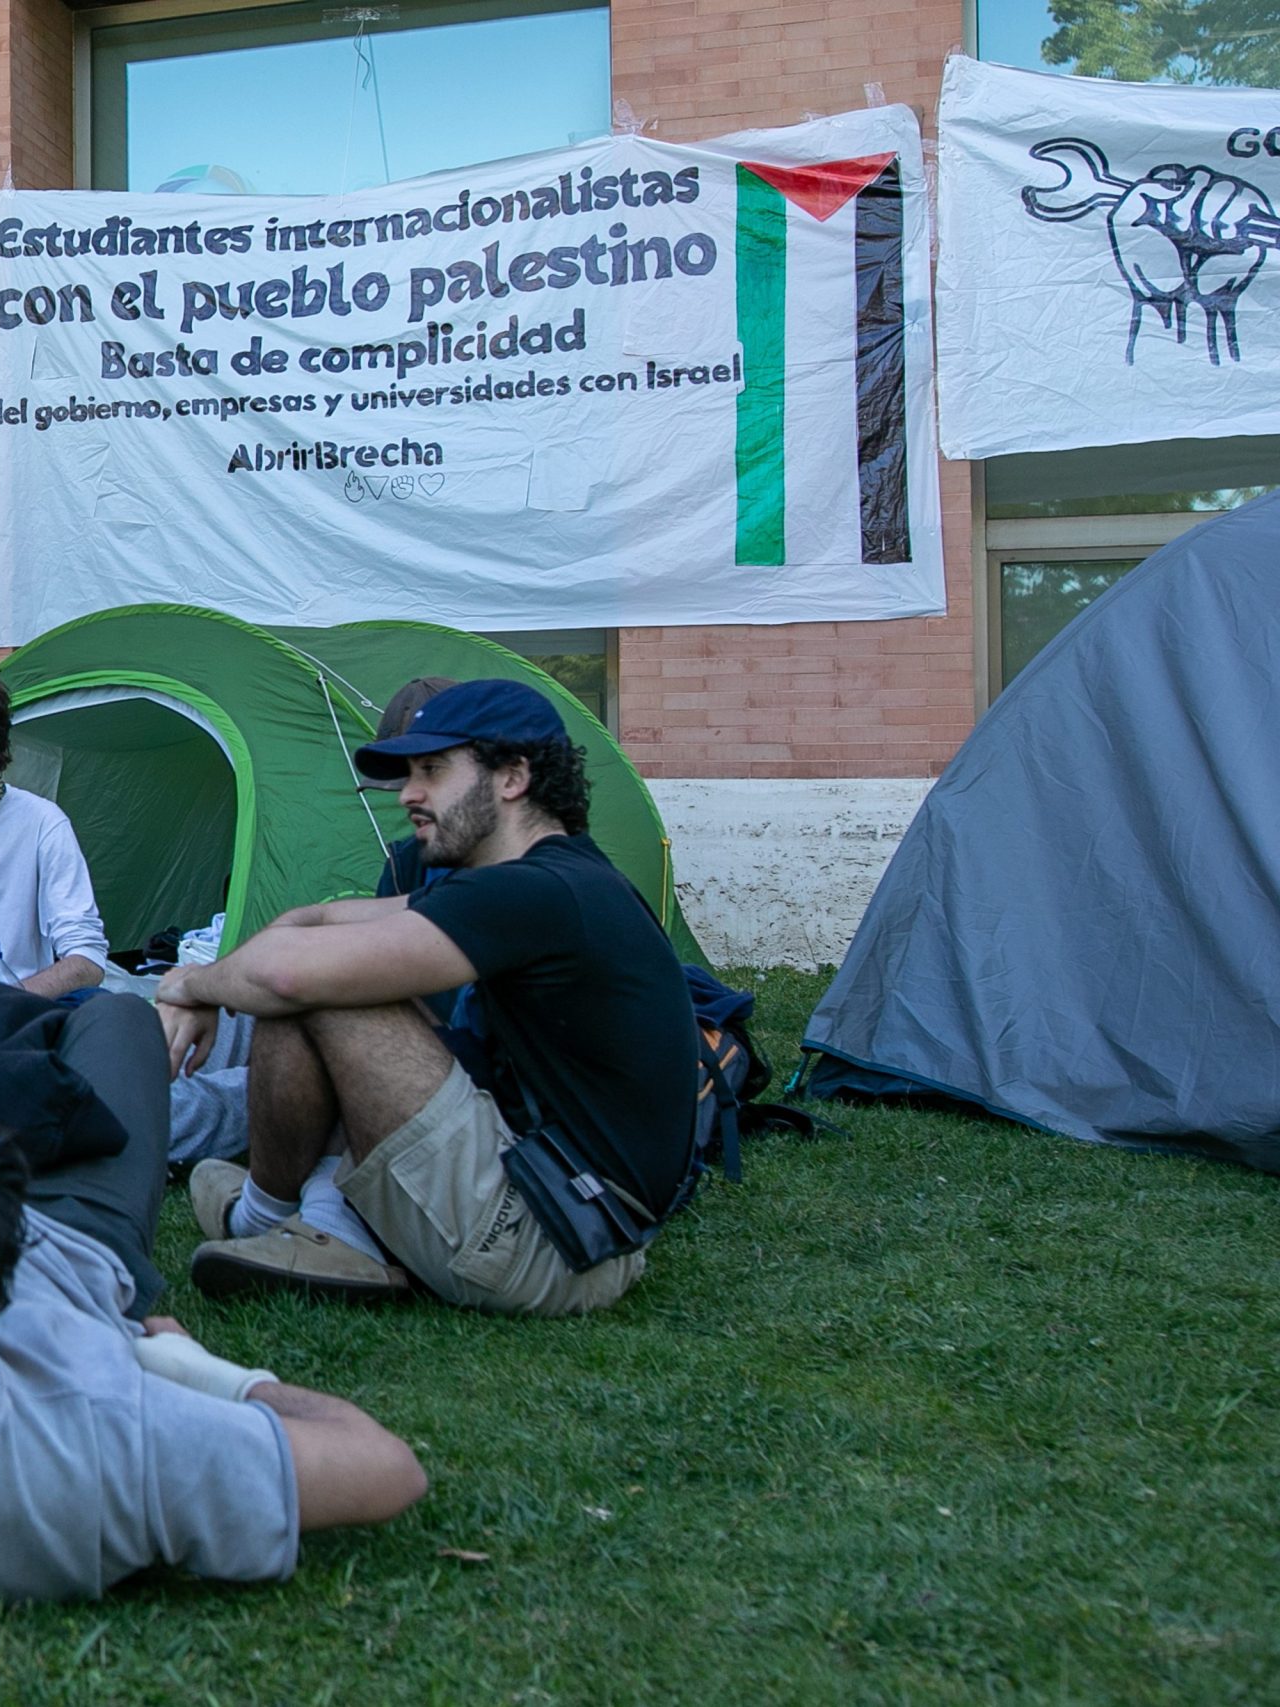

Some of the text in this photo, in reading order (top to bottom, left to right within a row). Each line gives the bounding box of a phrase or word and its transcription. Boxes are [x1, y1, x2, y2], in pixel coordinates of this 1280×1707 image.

[265, 166, 700, 252] internacionalistas
[110, 269, 166, 321] el
[179, 261, 391, 334] pueblo
[407, 222, 718, 323] palestino
[100, 307, 587, 380] Basta de complicidad
[34, 396, 171, 431] gobierno,
[175, 393, 317, 422] empresas
[324, 394, 344, 418] y
[350, 370, 572, 412] universidades
[578, 373, 638, 394] con
[646, 352, 742, 391] Israel
[227, 437, 444, 474] AbrirBrecha
[478, 1183, 517, 1252] DIADORA
